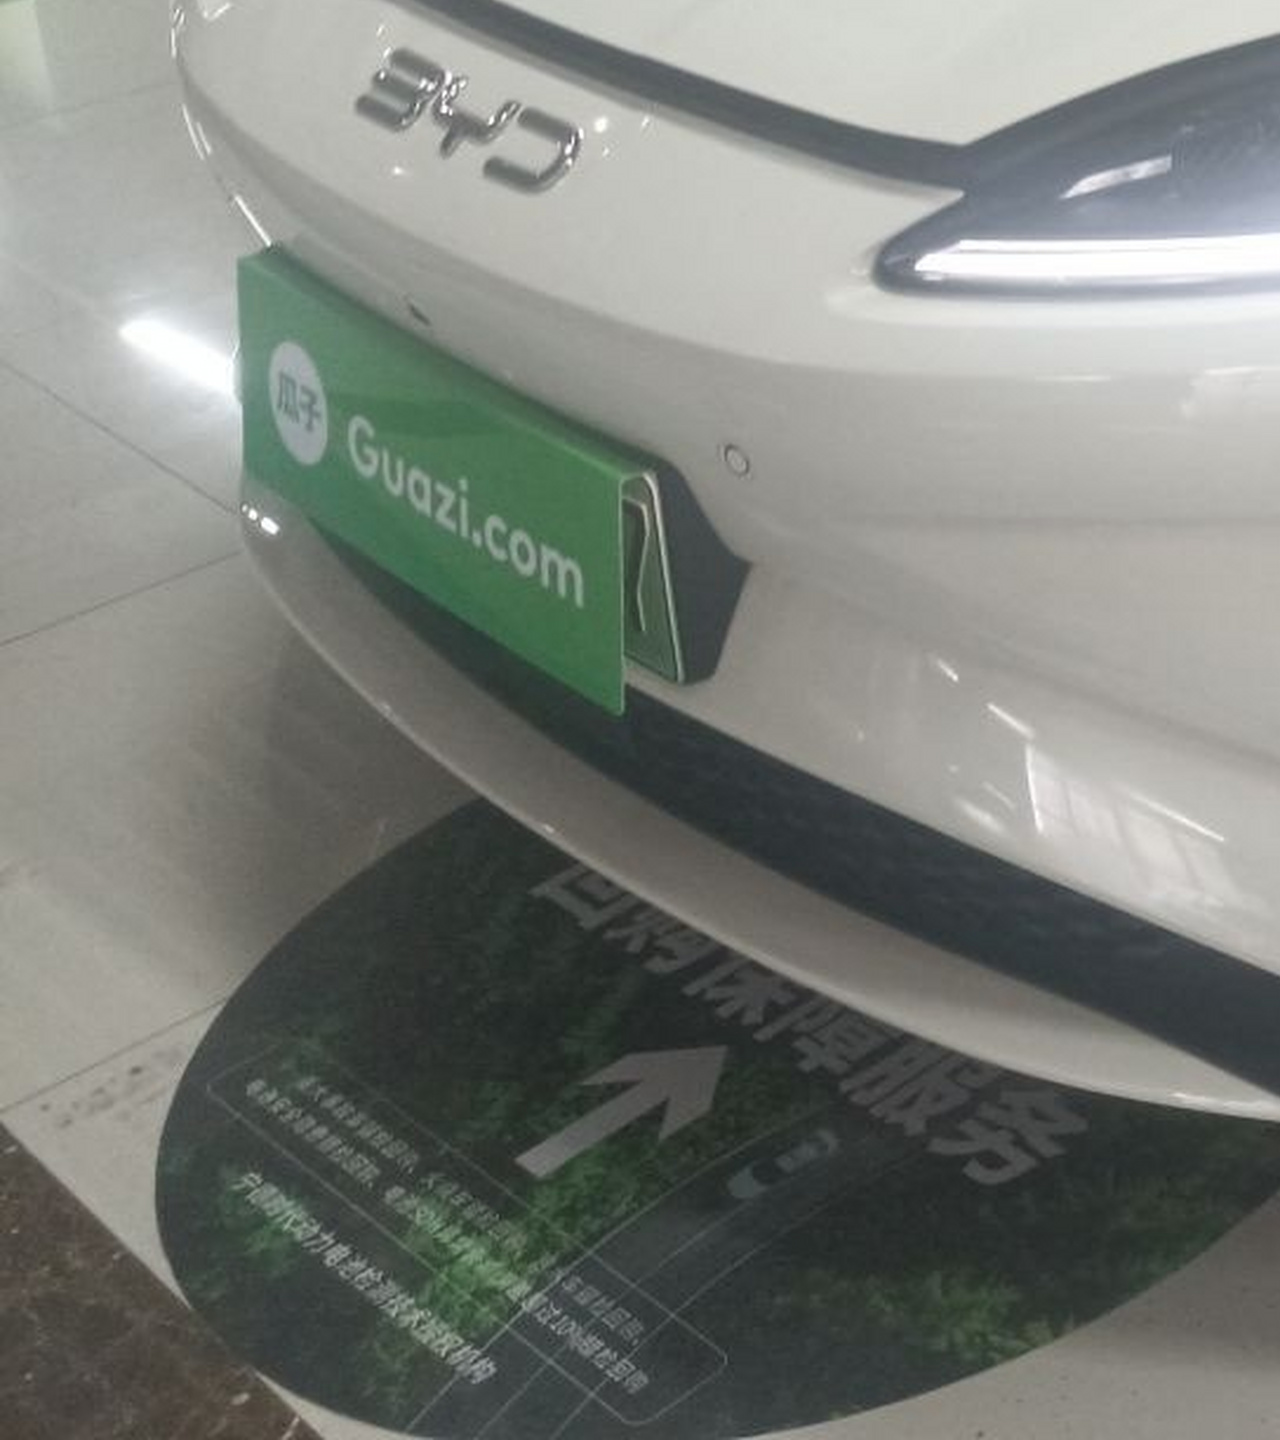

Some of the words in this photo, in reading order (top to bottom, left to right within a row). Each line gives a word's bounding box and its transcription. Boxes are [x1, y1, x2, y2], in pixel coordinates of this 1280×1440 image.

[354, 47, 585, 195] BYD
[277, 371, 321, 432] 瓜子
[348, 415, 585, 608] Guazi.com
